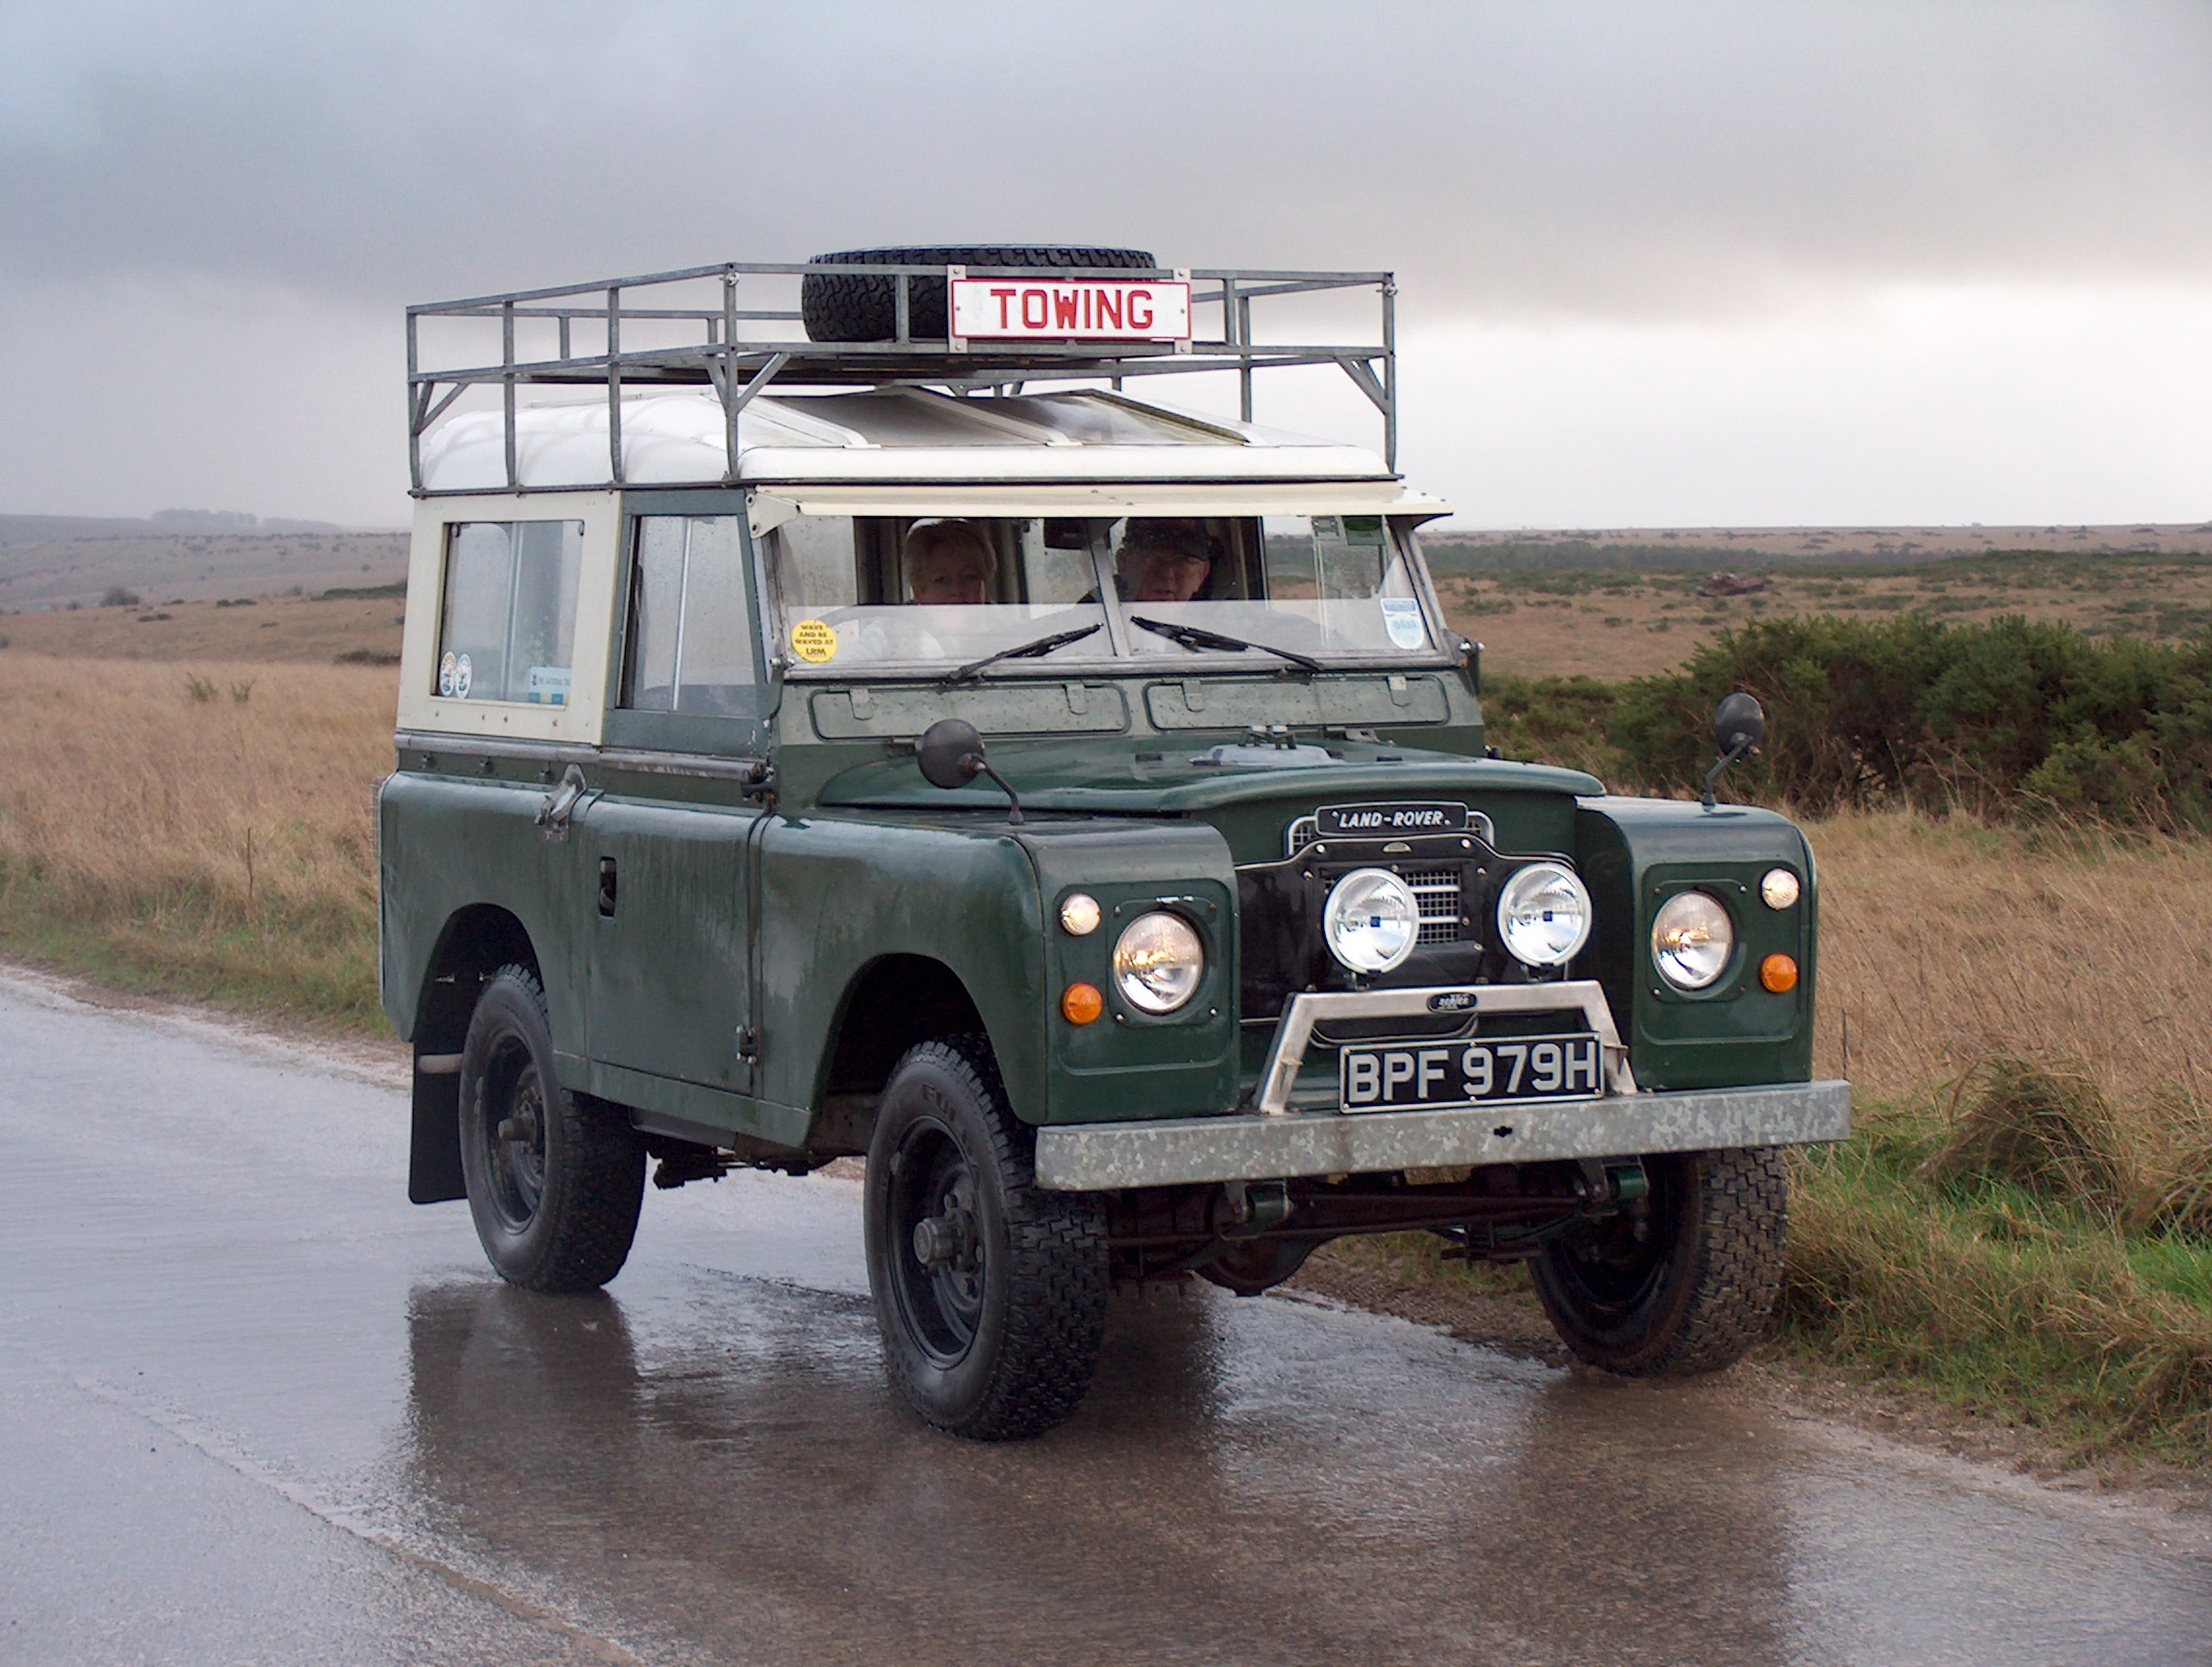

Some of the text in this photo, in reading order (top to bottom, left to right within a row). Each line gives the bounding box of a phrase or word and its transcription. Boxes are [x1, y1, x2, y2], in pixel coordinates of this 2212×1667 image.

[990, 288, 1153, 329] TOWING
[1339, 810, 1443, 828] LAND-ROVER
[1348, 1041, 1596, 1103] BPF 979H
